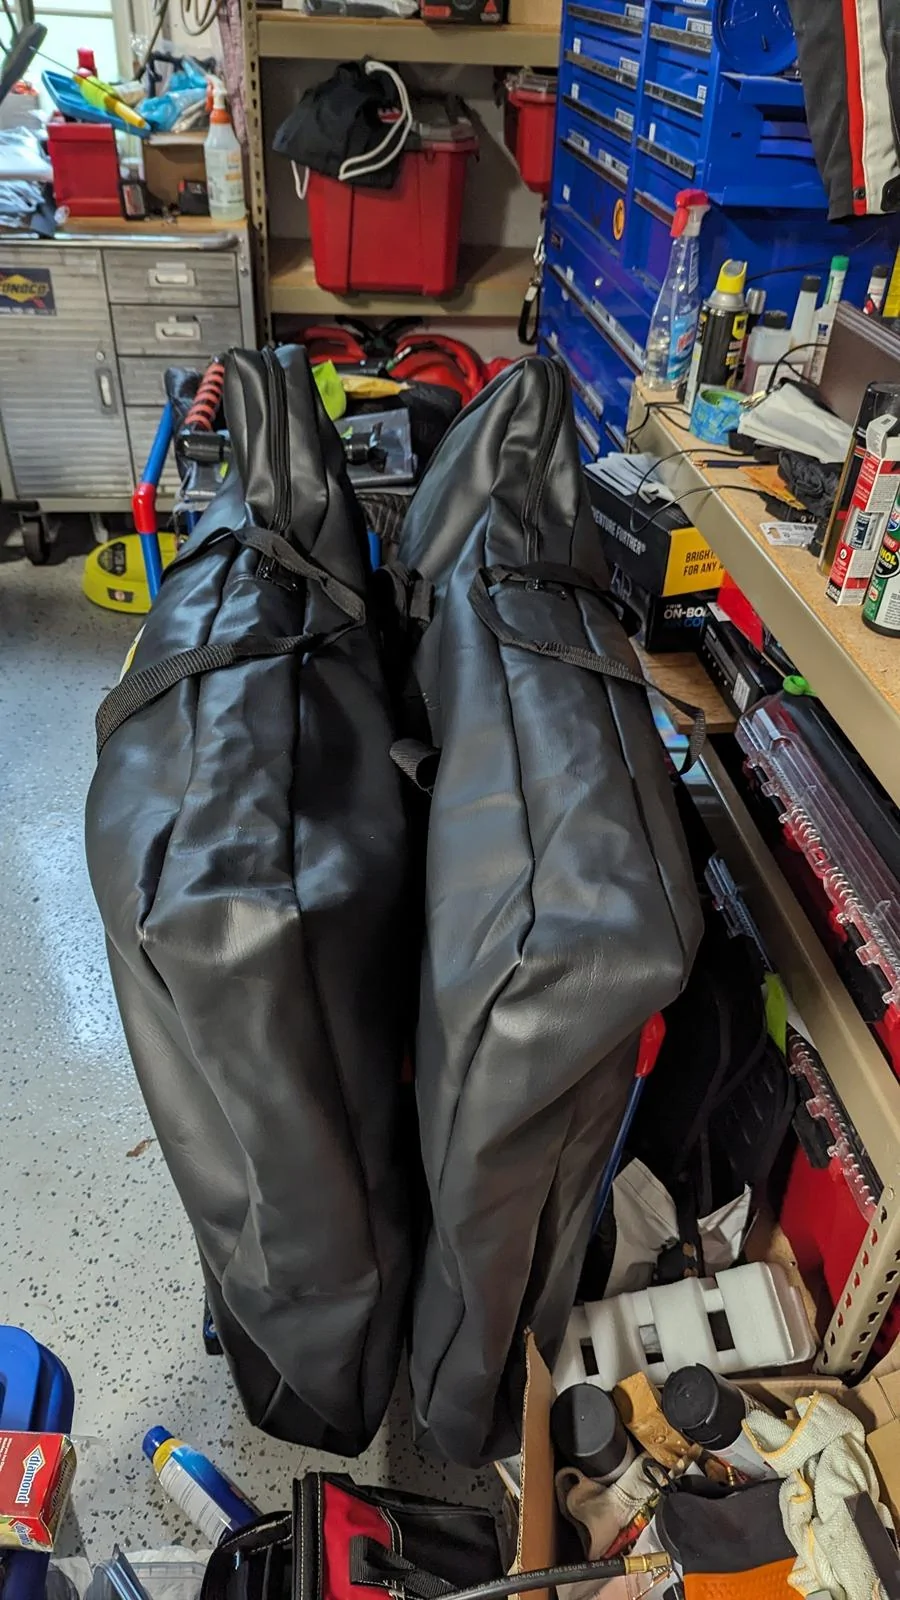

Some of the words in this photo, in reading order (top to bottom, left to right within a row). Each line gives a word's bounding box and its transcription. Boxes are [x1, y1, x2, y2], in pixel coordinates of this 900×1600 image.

[683, 564, 699, 576] FOR
[700, 561, 717, 573] ANY
[17, 1455, 40, 1502] diamond
